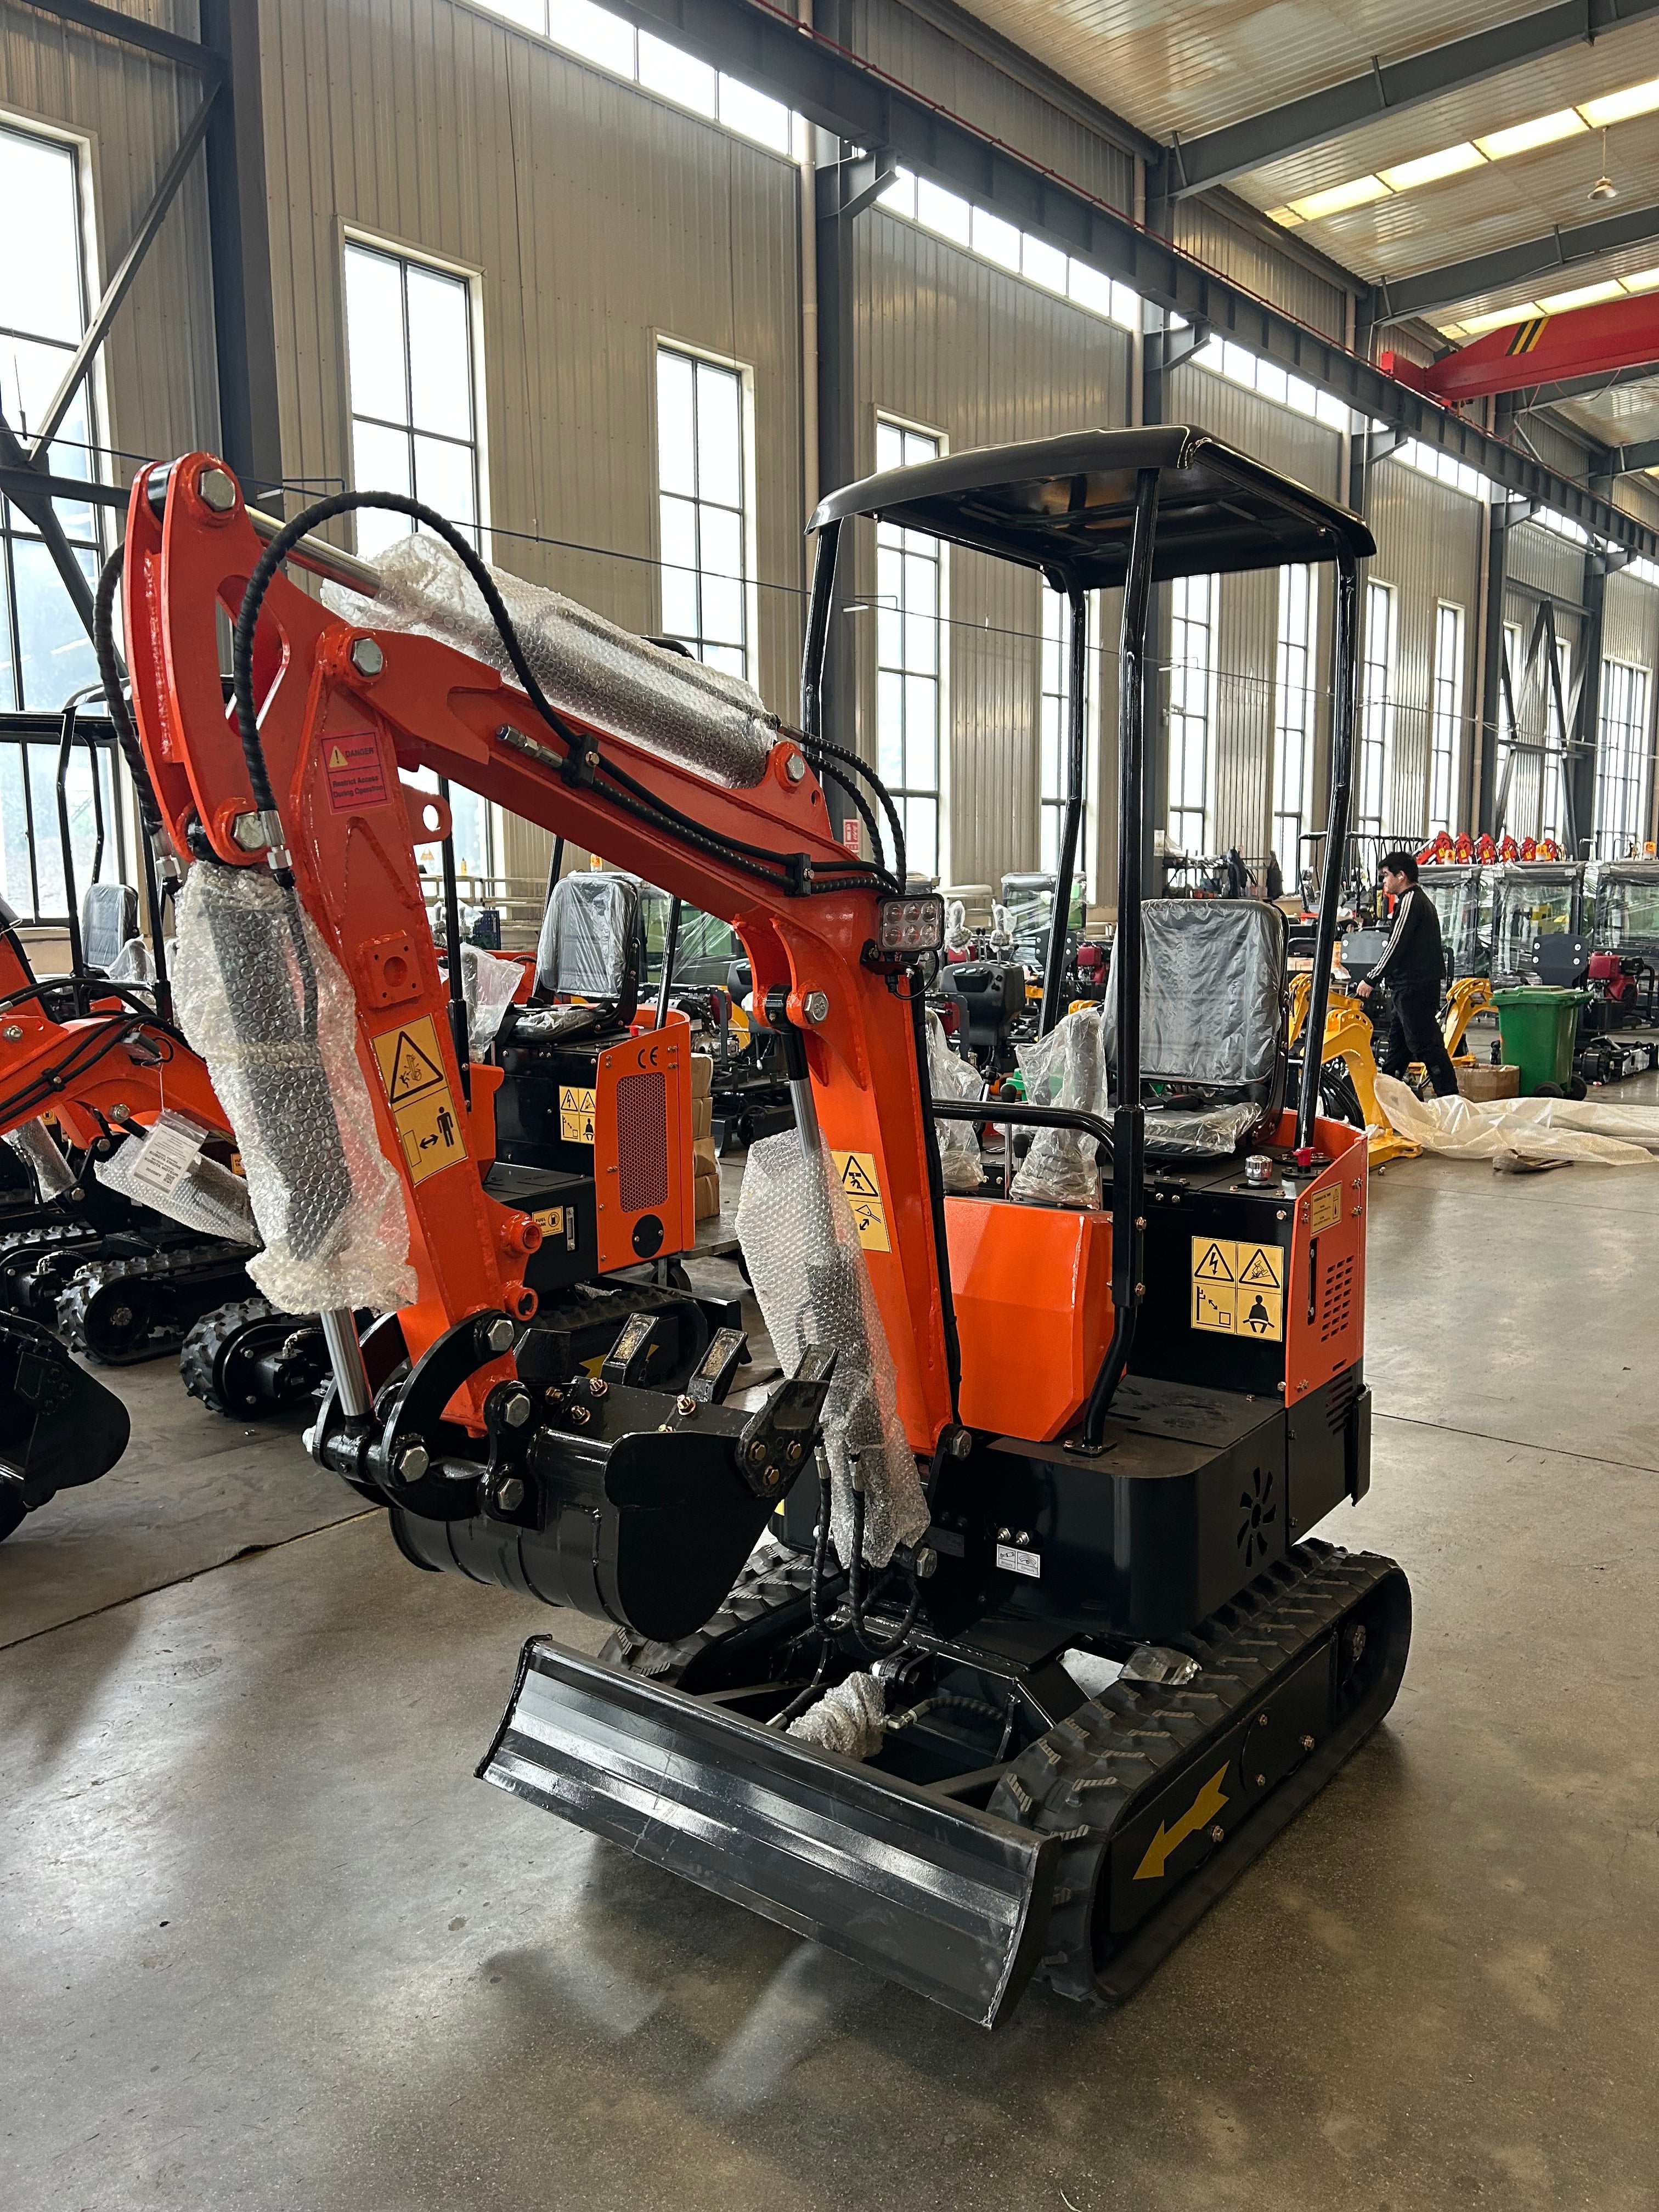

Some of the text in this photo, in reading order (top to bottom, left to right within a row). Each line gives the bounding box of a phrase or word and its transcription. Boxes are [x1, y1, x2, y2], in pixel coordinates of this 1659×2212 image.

[345, 747, 374, 758] DANGER
[333, 778, 356, 787] Restrict
[354, 785, 383, 795] Operation
[637, 1046, 659, 1069] CE
[144, 1157, 178, 1177] KUBOTA MOTEUR
[149, 1150, 166, 1161] KUBOTA
[166, 1160, 182, 1170] ENGINE
